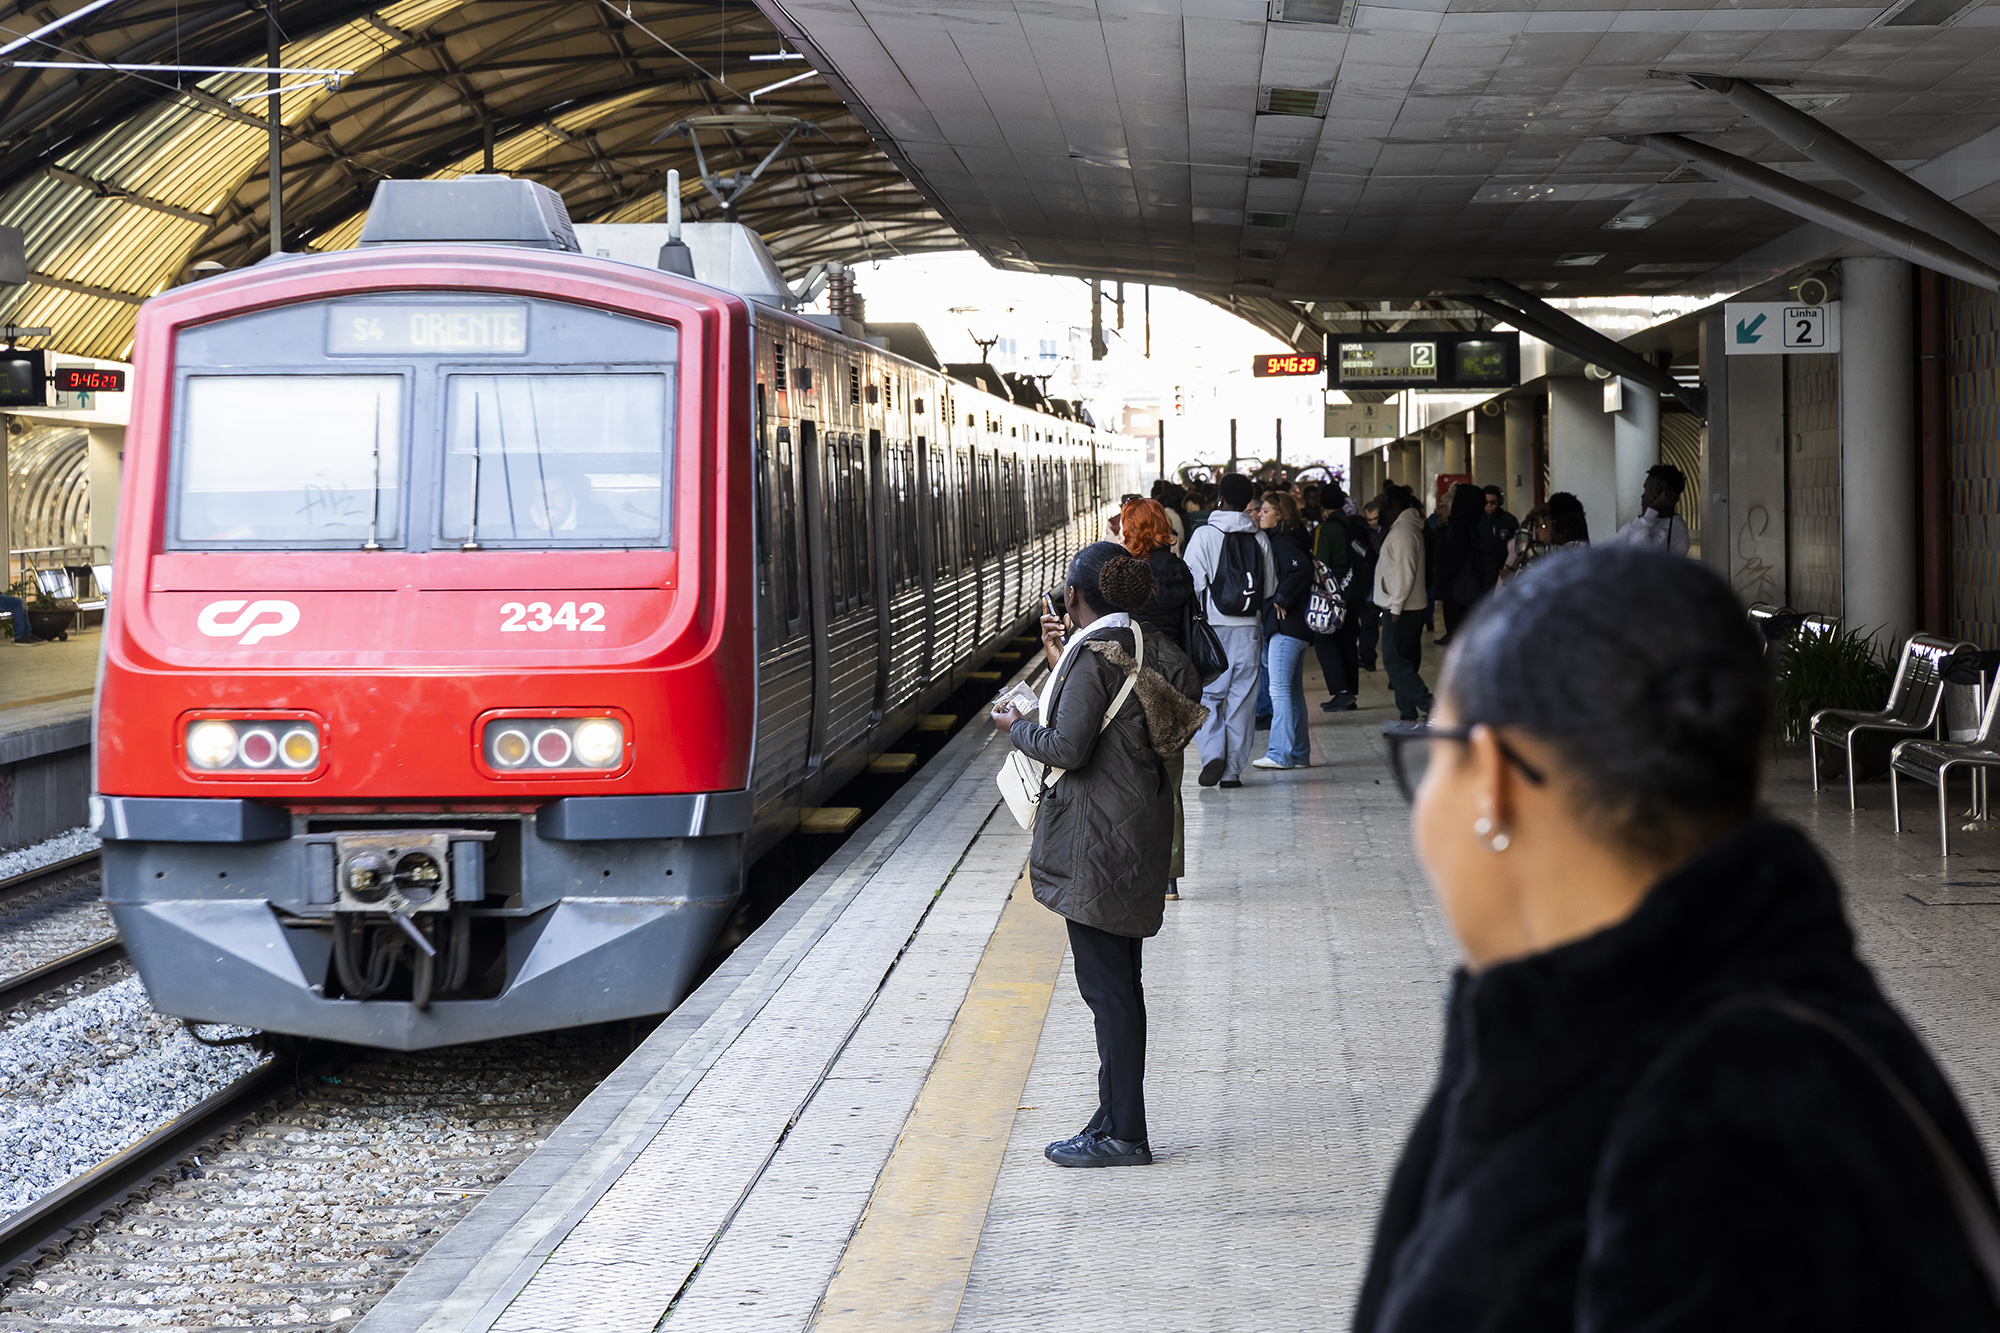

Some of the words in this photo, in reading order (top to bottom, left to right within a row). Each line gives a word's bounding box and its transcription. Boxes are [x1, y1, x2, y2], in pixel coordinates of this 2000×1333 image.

[1790, 309, 1817, 318] Linha
[352, 317, 385, 342] S4
[410, 313, 521, 346] ORIENTE
[1795, 319, 1812, 343] 2
[1342, 343, 1363, 352] HORA
[1416, 346, 1430, 366] 2
[1342, 361, 1374, 369] DESTINO
[197, 600, 301, 645] CP
[499, 601, 606, 632] 2342
